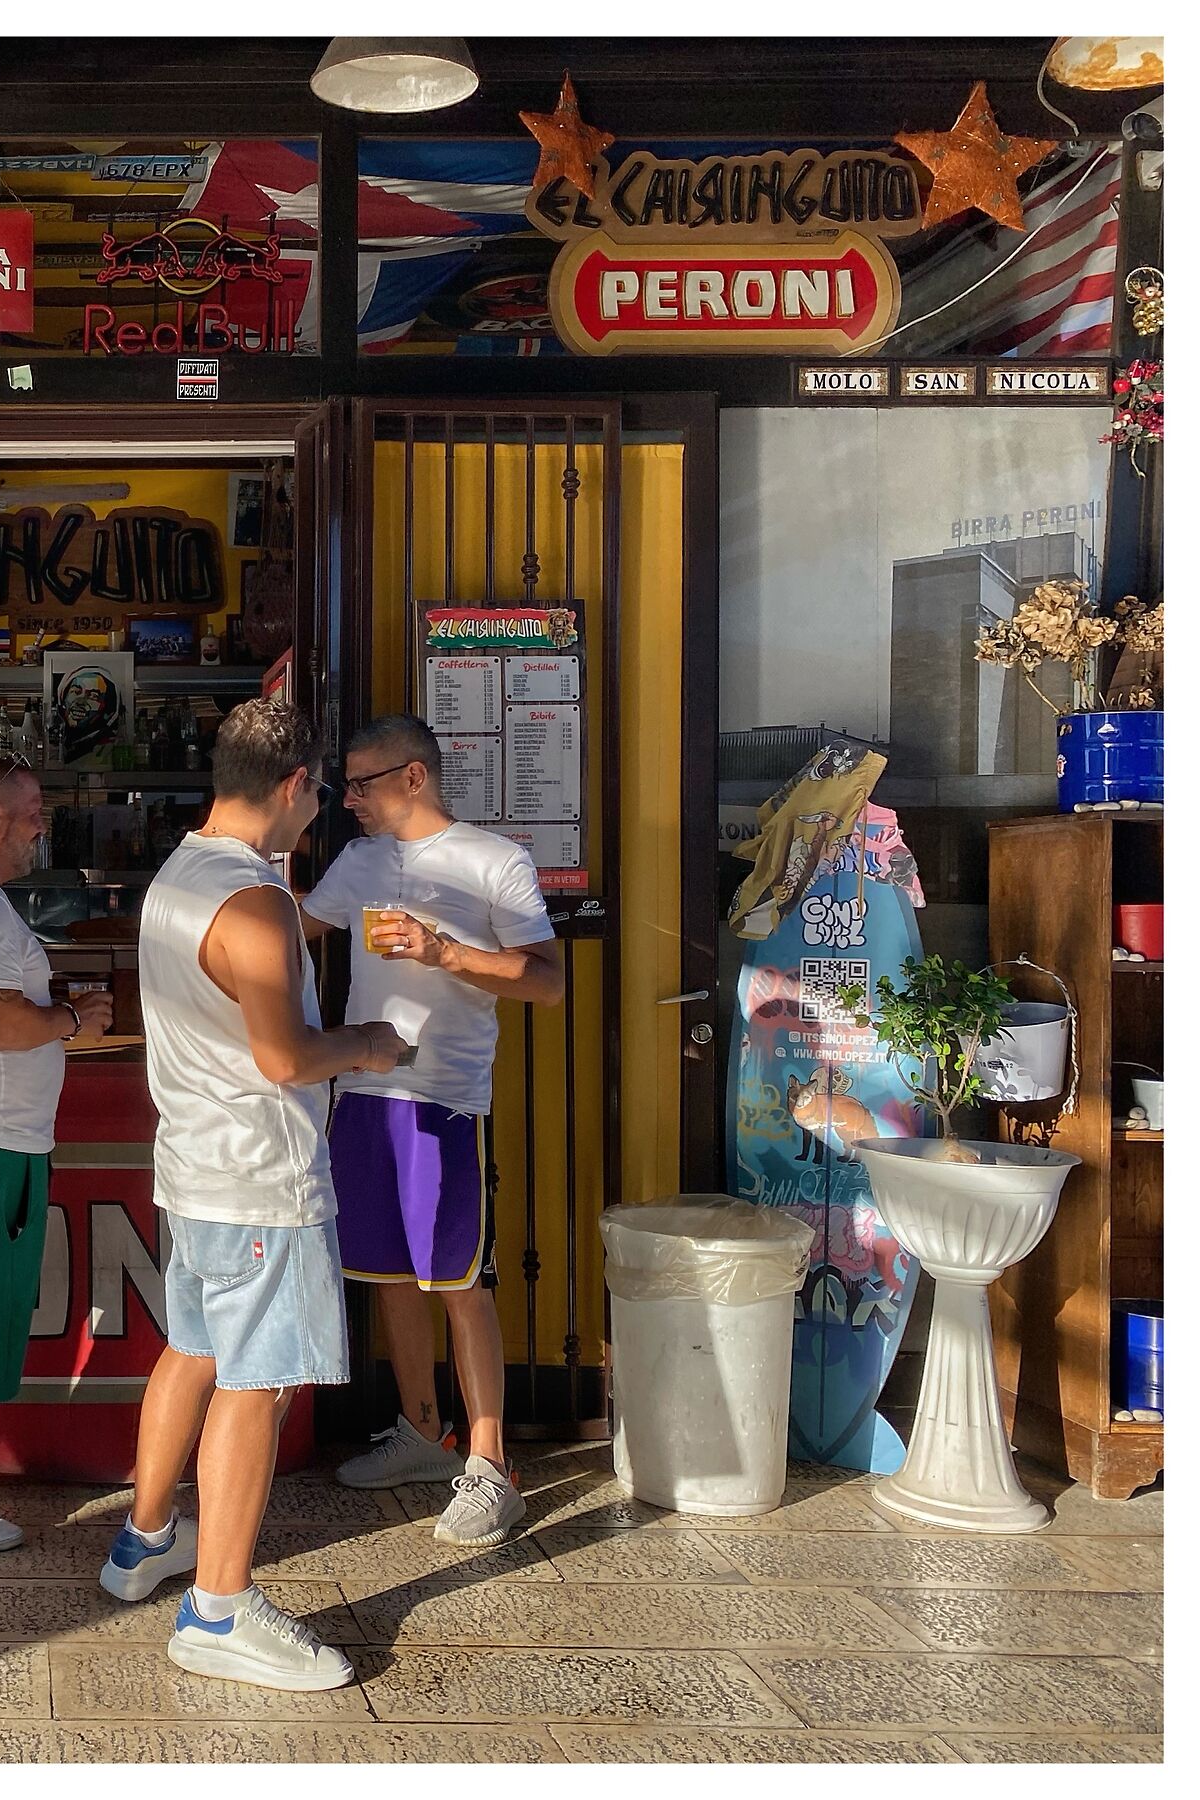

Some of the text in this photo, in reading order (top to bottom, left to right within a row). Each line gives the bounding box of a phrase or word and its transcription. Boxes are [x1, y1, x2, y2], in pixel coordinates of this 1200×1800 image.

[599, 269, 856, 320] PERONI
[83, 299, 297, 356] Red Bull
[178, 362, 217, 375] DIFFIDATI
[812, 372, 1092, 390] MOLO SAN NICOLA
[951, 513, 1013, 539] BIRRA
[438, 660, 490, 669] Caffetteria
[523, 662, 560, 673] Distillati
[529, 711, 557, 721] Bibite
[451, 741, 478, 750] Birre
